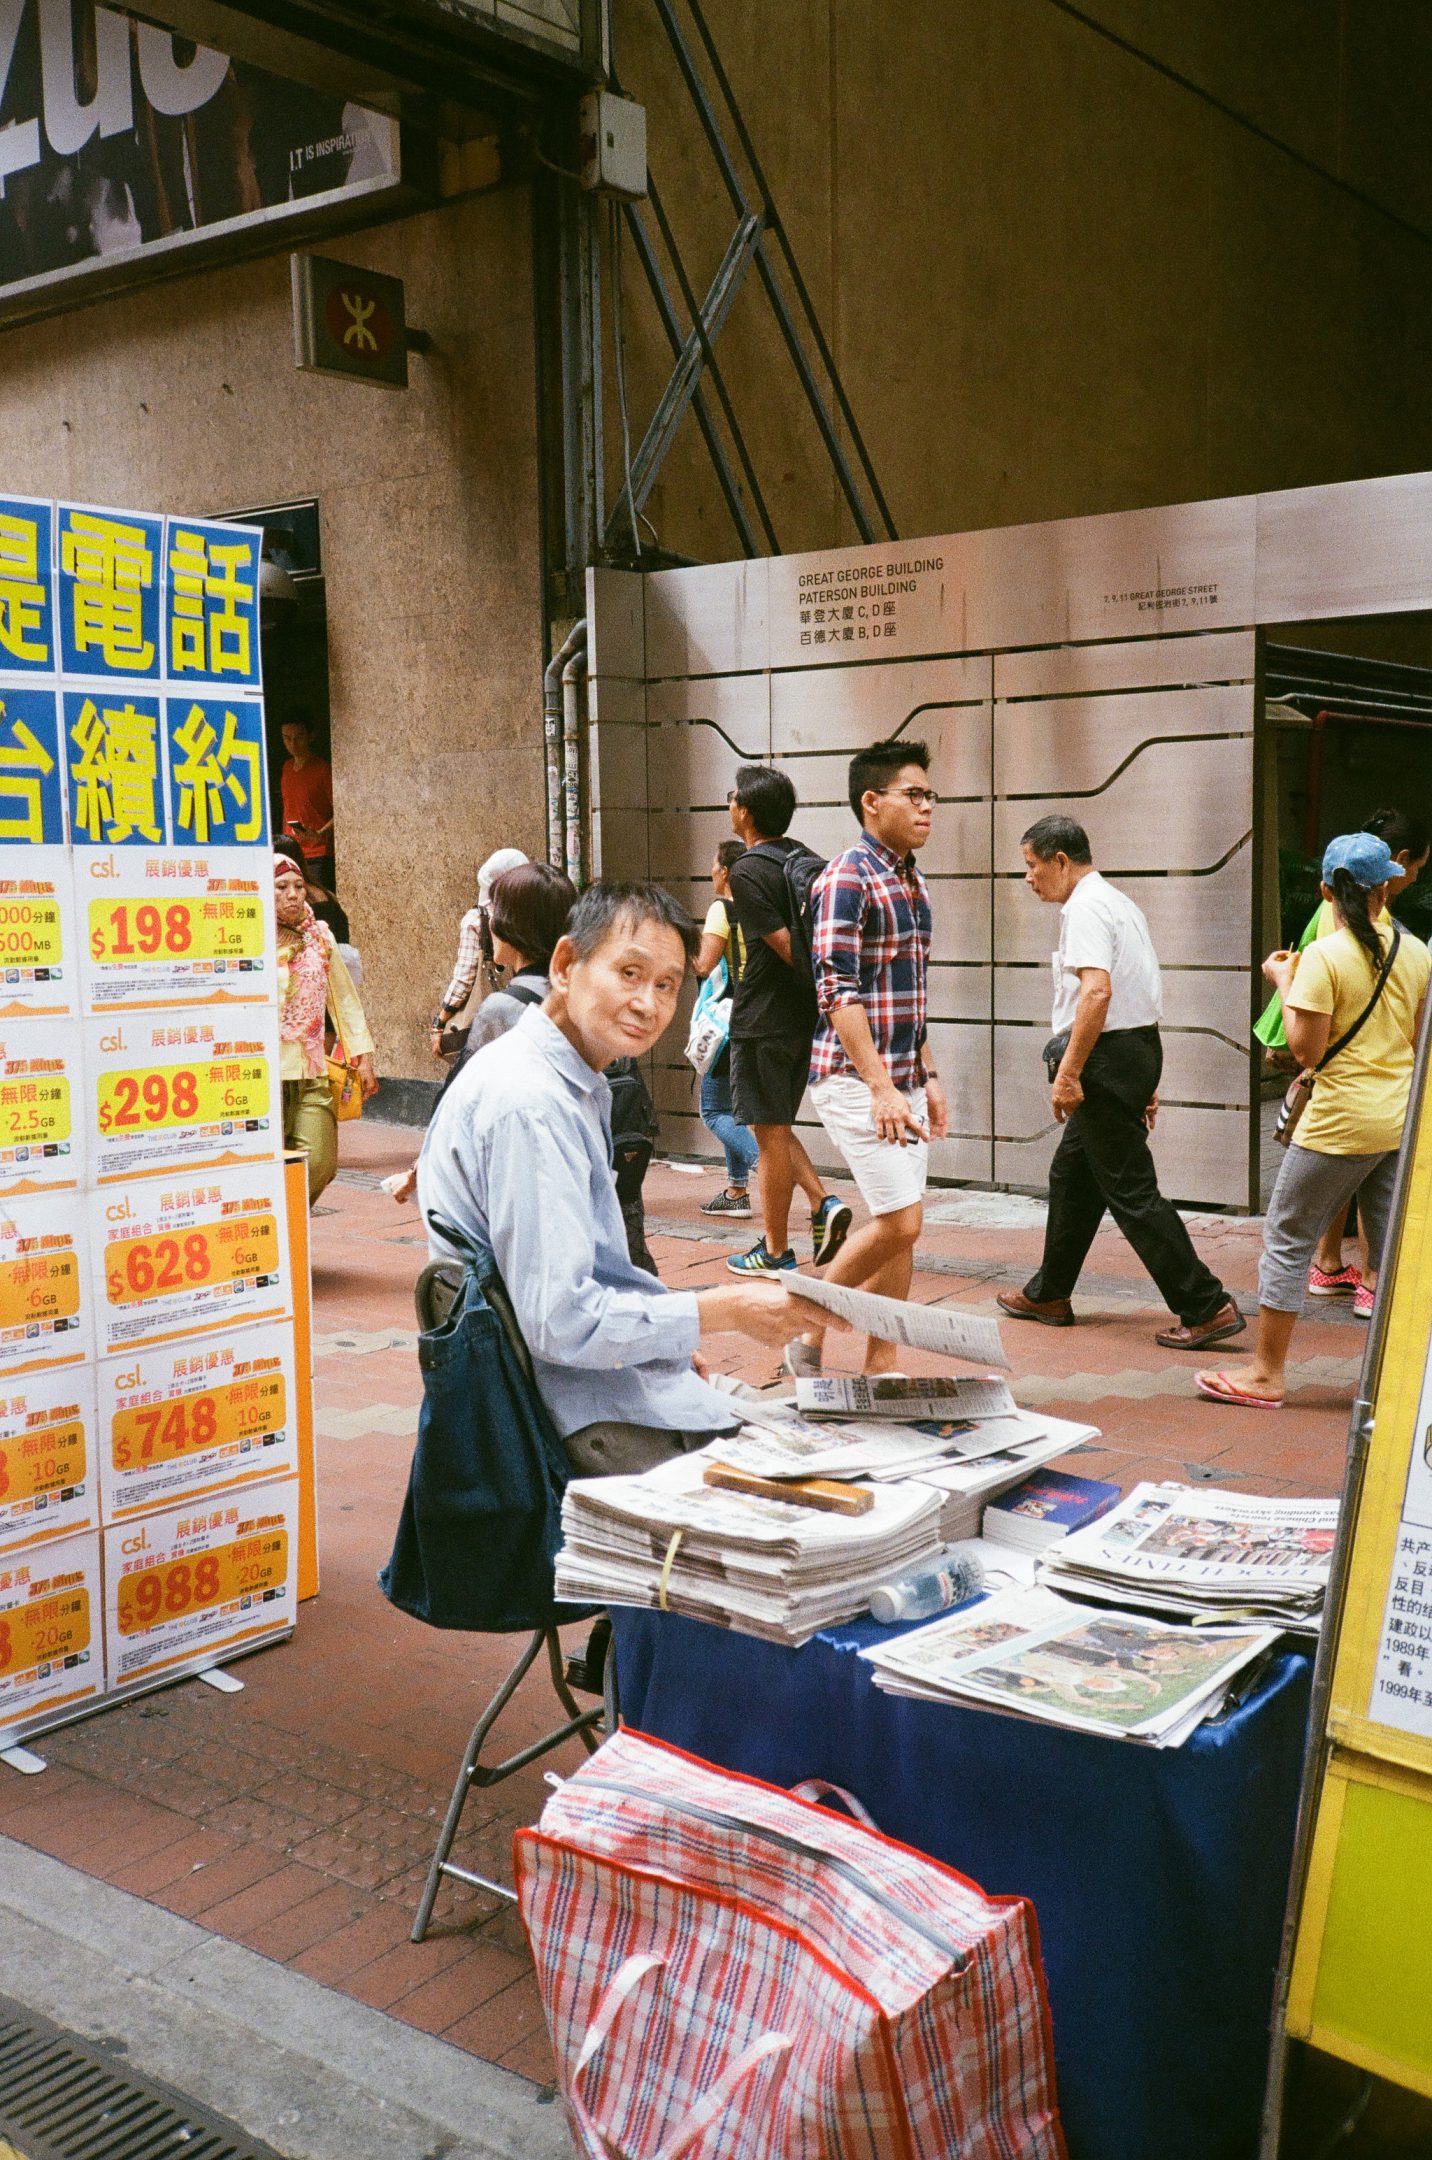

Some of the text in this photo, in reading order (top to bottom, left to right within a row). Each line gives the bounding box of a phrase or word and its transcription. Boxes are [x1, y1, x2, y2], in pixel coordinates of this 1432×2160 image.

[305, 145, 315, 160] IS
[798, 557, 944, 587] GREAT GEORGE BUILDING
[799, 580, 917, 605] PATERSON BUILDING
[1130, 591, 1154, 601] GREAT
[1156, 587, 1186, 598] GEORGE
[1188, 584, 1218, 595] STREET
[145, 859, 209, 877] 展銷優惠
[151, 1024, 215, 1047] 展銷優惠
[159, 1185, 223, 1212] 展銷優惠
[173, 1347, 235, 1378] 展銷優惠
[176, 1507, 239, 1539] 展銷優惠
[1386, 1637, 1430, 1661] 1989年
